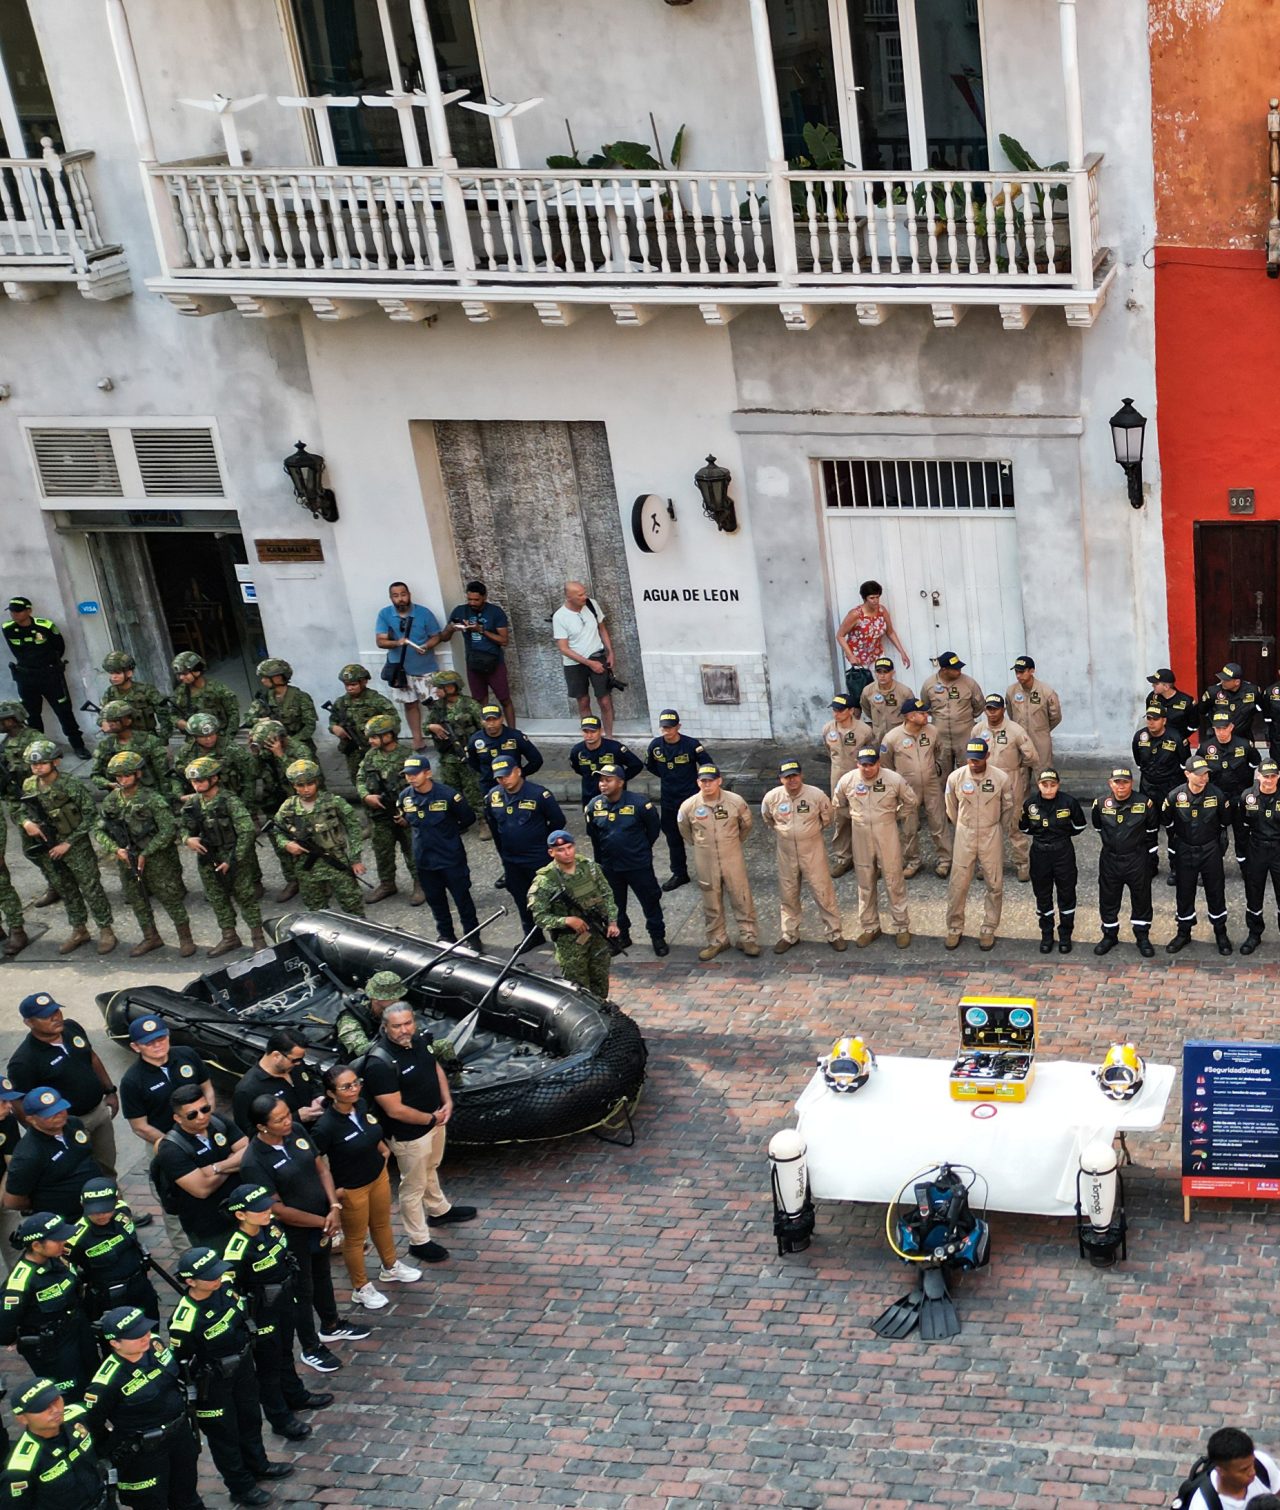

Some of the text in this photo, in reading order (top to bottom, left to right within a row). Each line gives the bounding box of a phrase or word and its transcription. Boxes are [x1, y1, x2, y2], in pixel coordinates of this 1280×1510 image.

[1231, 497, 1251, 506] 302
[643, 589, 739, 602] AGUA DE LEON
[82, 605, 98, 613] VISA
[1091, 1182, 1104, 1215] Torpedo
